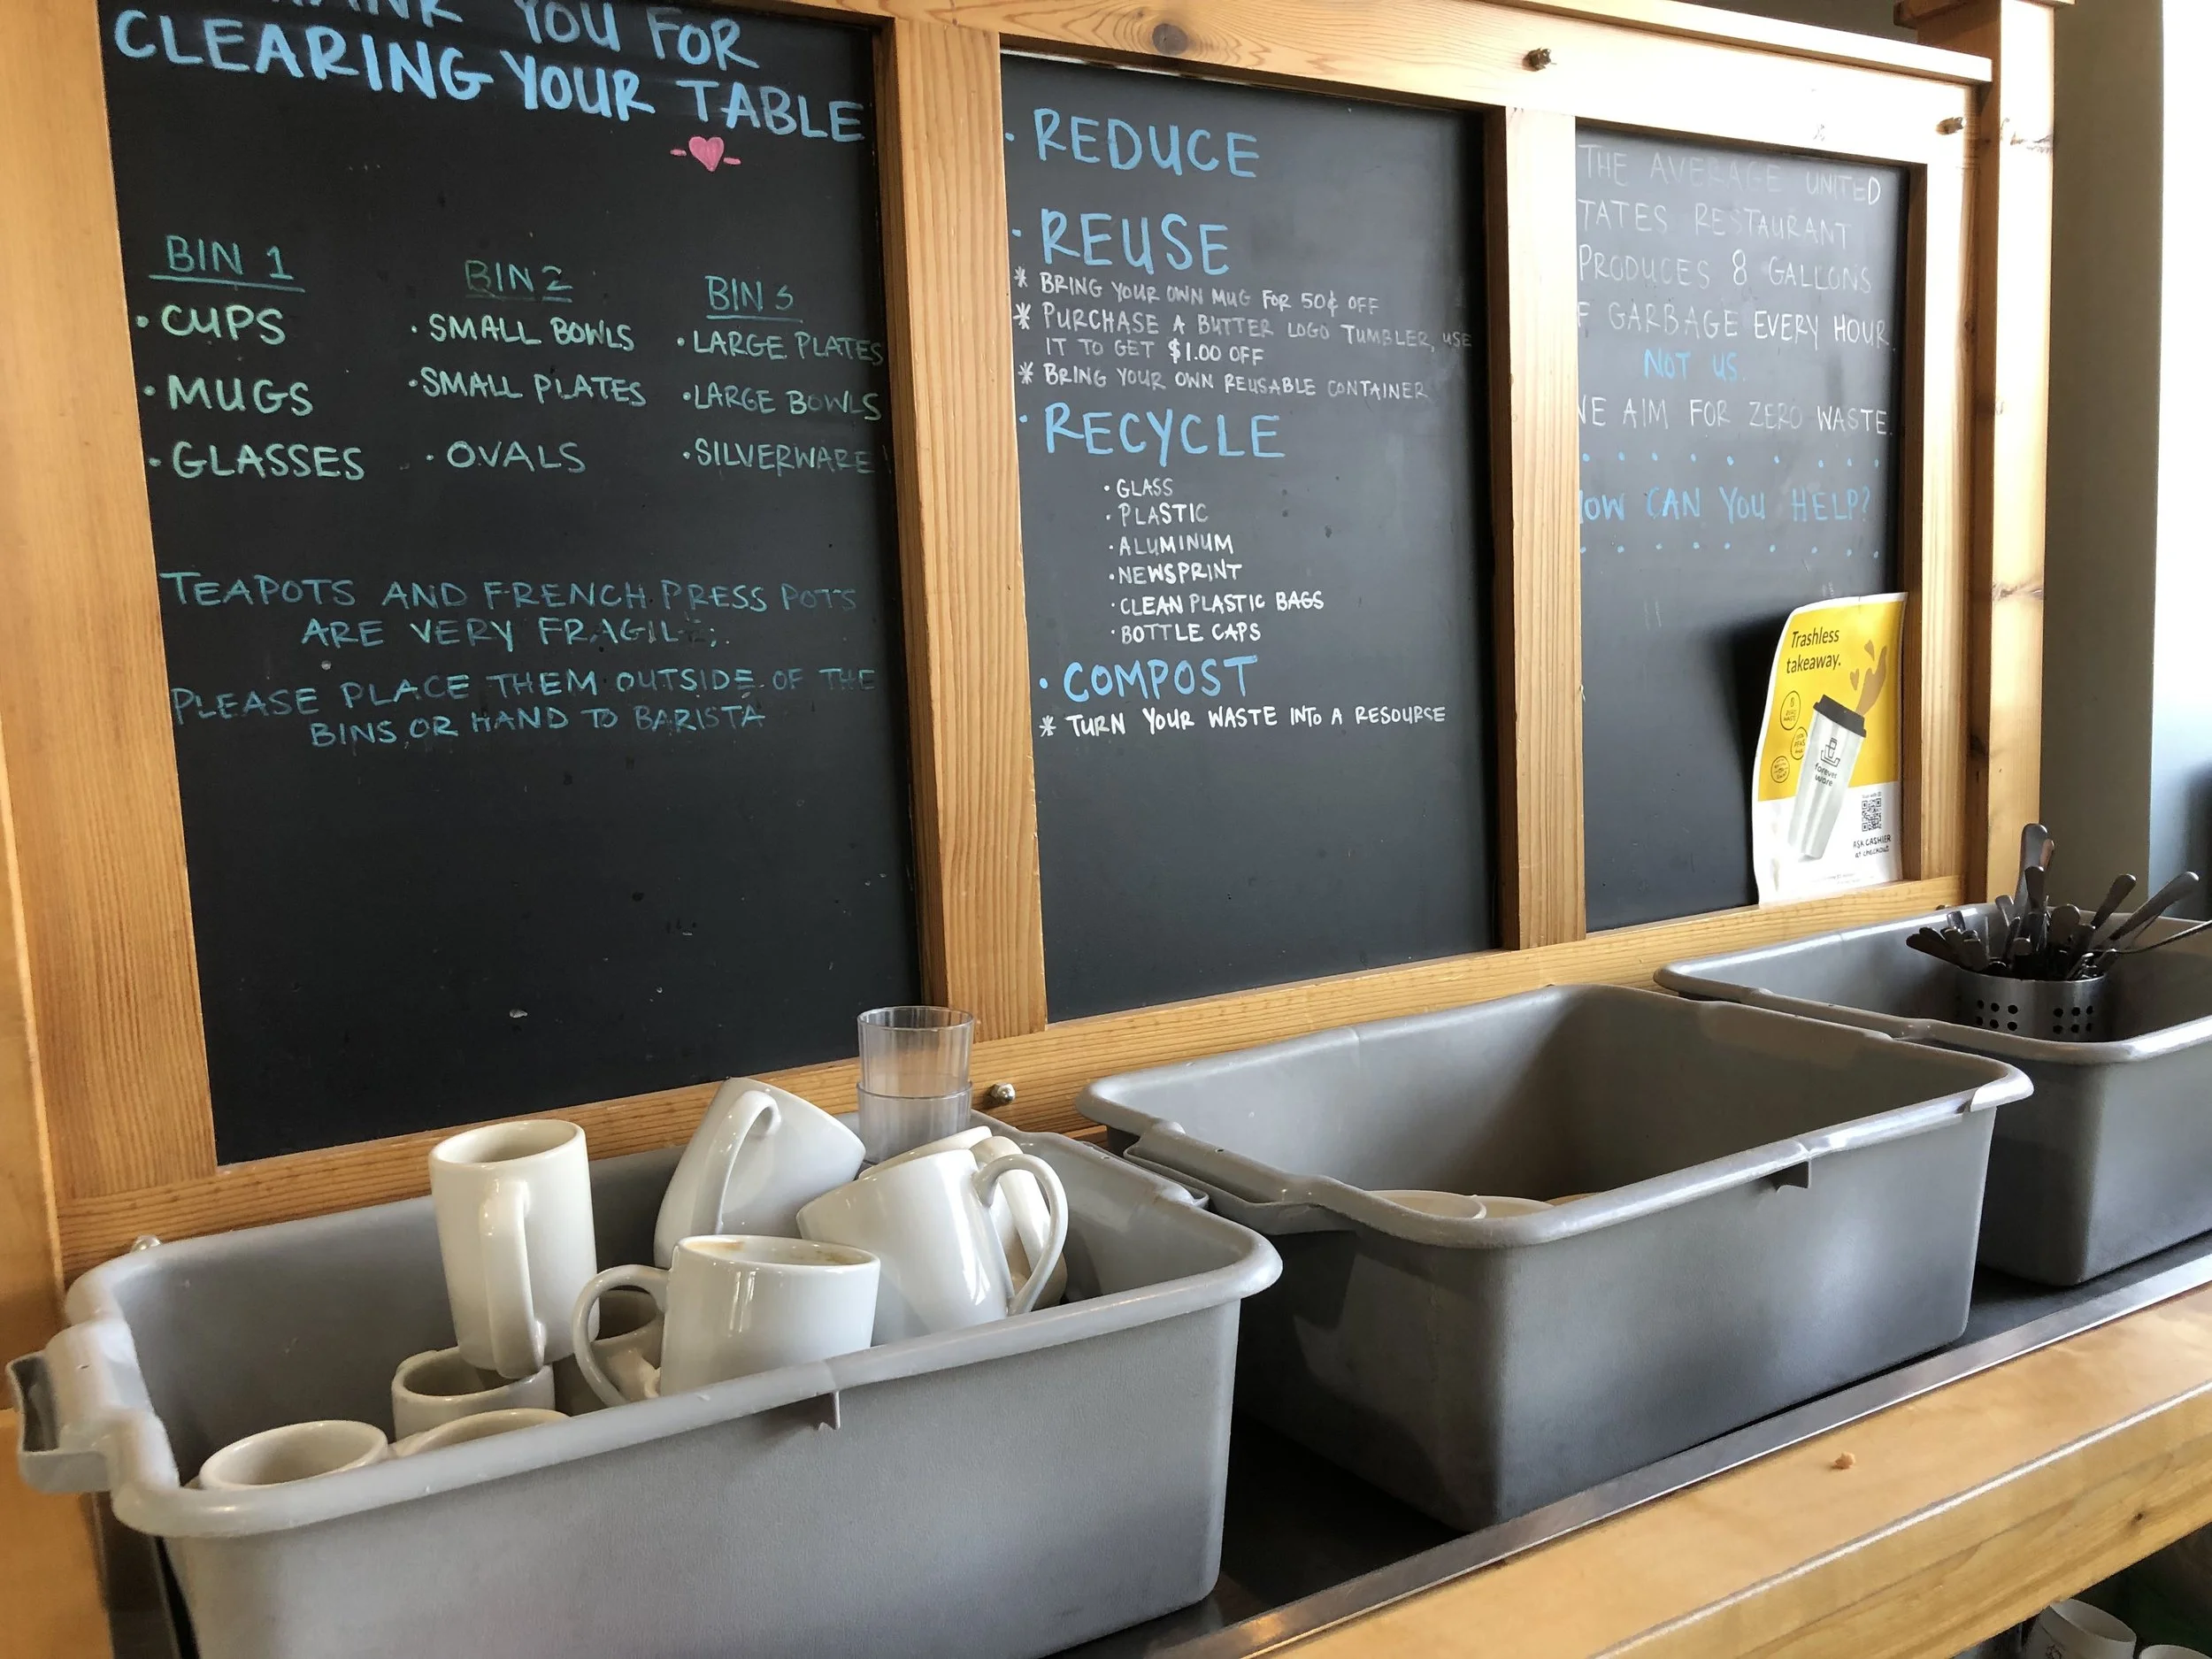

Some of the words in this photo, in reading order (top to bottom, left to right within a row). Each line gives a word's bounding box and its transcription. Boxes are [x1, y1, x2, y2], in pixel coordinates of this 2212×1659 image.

[514, 0, 621, 51] YOU
[647, 6, 759, 71] FOR
[114, 9, 494, 101] CLEARING
[500, 50, 656, 121] YOUR
[676, 80, 865, 142] TABLE
[1033, 108, 1259, 177] REDUCE
[1578, 144, 1627, 186] THE
[1650, 151, 1785, 193] AVERAGE
[1806, 171, 1881, 205] UNITED
[1041, 208, 1229, 275] REUSE
[1578, 199, 1668, 233] TATES
[1694, 203, 1851, 250] RESTAURANT
[166, 234, 244, 275] BIN
[266, 246, 294, 280] 1
[465, 259, 534, 293] BIN
[541, 265, 573, 291] 2
[1578, 243, 1710, 289] PRODUCES
[1732, 249, 1747, 285] 8
[1769, 256, 1872, 294] GALLONS
[705, 275, 764, 311] BIN
[1040, 272, 1102, 298] BRING
[1111, 280, 1161, 303] YOUR
[1166, 285, 1203, 305] OWN
[1211, 288, 1251, 308] MUG
[1262, 289, 1292, 311] FOR
[1301, 290, 1339, 317] 50¢
[1348, 296, 1379, 314] OFF
[161, 304, 287, 345] CUPS
[429, 313, 542, 344] SMALL
[550, 317, 635, 351] BOWLS
[1041, 302, 1160, 335] PURCHASE
[1172, 314, 1185, 335] A
[1198, 313, 1274, 338] BUTTER
[1287, 322, 1330, 340] LOGO
[1443, 332, 1472, 347] USE
[1578, 302, 1590, 328] F
[1609, 302, 1739, 339] GARBAGE
[1754, 311, 1818, 350] EVERY
[694, 330, 787, 360] LARGE
[795, 331, 884, 365] PLATES
[1046, 337, 1067, 356] IT
[1078, 338, 1103, 356] TO
[1114, 339, 1155, 358] GET
[1168, 337, 1221, 364] $1.00
[1229, 345, 1264, 365] OFF
[1644, 348, 1691, 380] NOT
[168, 374, 313, 417] MUGS
[420, 366, 523, 398] SMALL
[534, 374, 647, 406] PLATES
[695, 381, 776, 413] LARGE
[785, 389, 881, 420] BOWLS
[1043, 363, 1107, 388] BRING
[1116, 367, 1166, 390] YOUR
[1175, 372, 1214, 389] OWN
[1225, 373, 1317, 396] REUSABLE
[1327, 380, 1429, 401] CONTAINER
[1623, 397, 1669, 429] AIM
[1690, 399, 1731, 426] FOR
[1748, 401, 1802, 429] ZERO
[1045, 402, 1286, 467] RECYCLE
[173, 441, 365, 480] GLASSES
[447, 441, 586, 472] OVALS
[695, 438, 875, 476] SILVERWARE
[1117, 478, 1174, 498] GLASS
[1646, 487, 1701, 519] CAN
[1718, 486, 1765, 523] YOU
[1791, 486, 1870, 521] HELP?
[1118, 502, 1209, 526] PLASTIC
[1118, 533, 1233, 556] ALUMINUM
[1118, 558, 1242, 585] NEWSPRINT
[159, 572, 356, 607] TEAPOTS
[382, 581, 467, 610] AND
[484, 581, 647, 610] FRENCH
[661, 579, 768, 612] PRESS
[780, 583, 856, 611] POTS
[1120, 595, 1183, 616] CLEAN
[1189, 594, 1265, 614] PLASTIC
[1276, 590, 1325, 611] BAGS
[301, 618, 384, 649] ARE
[410, 619, 513, 652] VERY
[538, 617, 703, 645] FRAGIL
[1121, 623, 1203, 644] BOTTLE
[1211, 621, 1262, 642] CAPS
[1791, 627, 1839, 649] Trashless
[1064, 655, 1258, 703] COMPOST
[1786, 653, 1841, 674] takeaway.
[170, 687, 319, 726] PLEASE
[340, 674, 470, 709] PLACE
[486, 668, 598, 698] THEM
[617, 667, 755, 693] OUTSIDE
[772, 668, 803, 690] OF
[819, 667, 875, 690] THE
[311, 719, 397, 747] BINS
[410, 715, 458, 739] OR
[471, 706, 568, 733] HAND
[580, 708, 618, 729] TO
[634, 705, 765, 733] BARISTA
[1065, 712, 1125, 737] TURN
[1142, 707, 1194, 737] YOUR
[1208, 706, 1278, 729] WASTE
[1331, 708, 1343, 726] A
[1815, 763, 1837, 779] forever
[1815, 774, 1832, 786] ware
[1853, 840, 1864, 849] ASK
[1865, 834, 1891, 846] CASHIER
